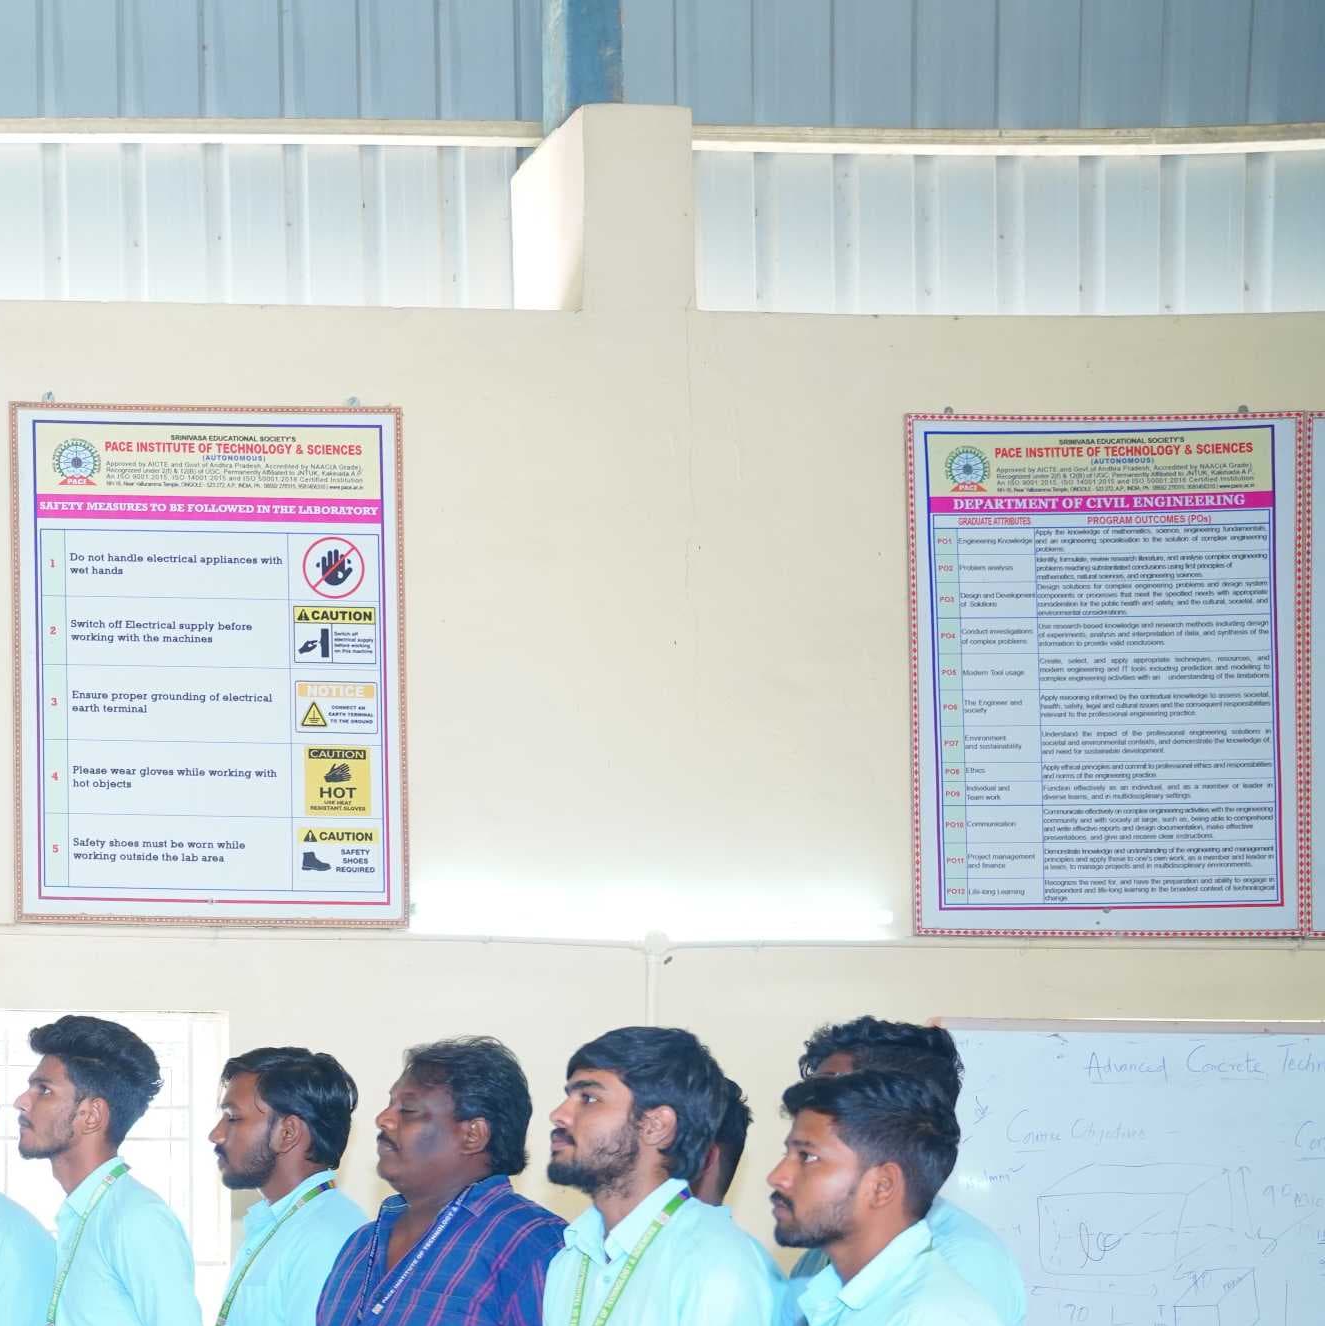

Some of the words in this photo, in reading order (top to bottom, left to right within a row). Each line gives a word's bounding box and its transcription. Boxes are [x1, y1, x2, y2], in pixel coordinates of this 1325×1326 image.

[104, 441, 132, 451] PACE
[136, 442, 195, 453] INSTITUTE
[198, 442, 212, 453] OF
[215, 443, 291, 454] TECHNOLOGY
[295, 444, 303, 454] &
[307, 444, 362, 455] SCIENCES
[995, 447, 1021, 458] PACE
[1026, 446, 1083, 458] INSTITUTE
[1086, 446, 1100, 456] OF
[1103, 444, 1180, 456] TECHNOLOGY
[1184, 444, 1192, 454] &
[1196, 442, 1253, 454] SCIENCES
[953, 498, 1058, 510] DEPARTMENT
[1062, 498, 1083, 508] OF
[1086, 496, 1130, 508] CIVIL
[1133, 494, 1245, 508] ENGINEERING
[40, 502, 83, 510] SAFETY
[86, 502, 148, 512] MEASURES
[150, 503, 166, 512] TO
[170, 503, 185, 512] BE
[188, 503, 254, 513] FOLLOWED
[257, 504, 271, 514] IN
[274, 504, 295, 514] THE
[299, 504, 378, 516] LABORATORY
[958, 517, 992, 525] GRADUATE
[993, 516, 1031, 525] ATTRIBUTES
[1087, 516, 1132, 524] PROGRAM
[1136, 515, 1186, 524] OUTCOMES
[1188, 514, 1211, 523] (POs)
[69, 552, 84, 561] Do
[107, 553, 143, 562] handle
[146, 554, 196, 563] electrical
[199, 555, 257, 566] appliances
[260, 556, 282, 564] with
[91, 566, 123, 574] hands
[311, 610, 374, 624] CAUTION
[50, 626, 56, 634] 2
[70, 619, 105, 628] Switch
[108, 620, 122, 628] off
[125, 620, 175, 629] Electrical
[178, 620, 214, 632] supply
[218, 621, 252, 630] before
[70, 632, 113, 643] working
[117, 633, 140, 641] with
[143, 633, 159, 642] the
[162, 634, 212, 643] machines
[72, 690, 108, 699] Ensure
[111, 693, 147, 702] proper
[150, 691, 205, 703] grounding
[209, 692, 219, 701] of
[222, 692, 272, 702] electrical
[307, 685, 364, 697] NOTICE
[51, 697, 57, 705] 3
[72, 703, 99, 712] earth
[103, 704, 147, 713] terminal
[310, 750, 364, 759] CAUTION
[51, 772, 58, 780] 4
[72, 765, 107, 774] Please
[139, 766, 173, 777] gloves
[176, 767, 205, 776] while
[208, 768, 251, 779] working
[254, 768, 277, 777] with
[73, 778, 88, 787] hot
[92, 779, 131, 789] objects
[320, 787, 356, 798] HOT
[319, 832, 372, 841] CAUTION
[52, 844, 58, 852] 5
[73, 837, 105, 848] Safety
[109, 838, 139, 847] shoes
[142, 839, 167, 848] must
[170, 839, 184, 848] be
[216, 840, 245, 849] while
[73, 850, 116, 862] working
[119, 852, 158, 861] outside
[161, 852, 178, 861] the
[181, 853, 198, 861] lab
